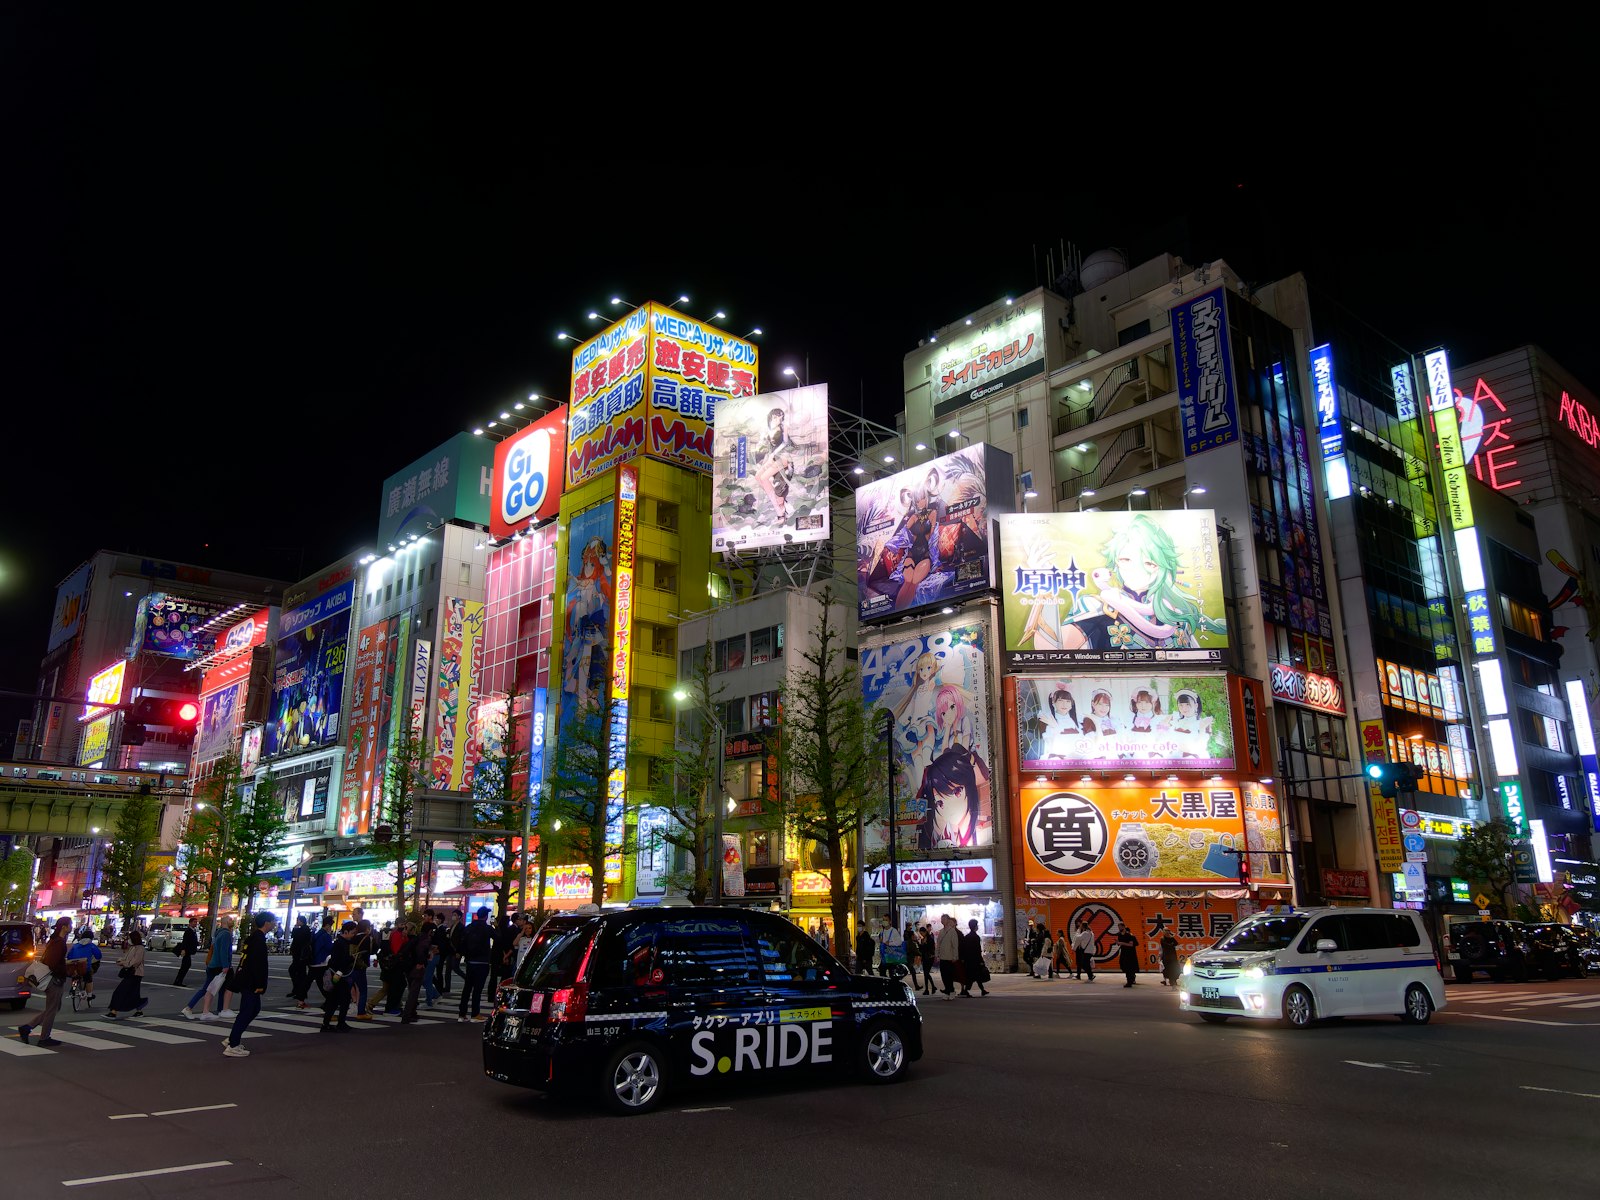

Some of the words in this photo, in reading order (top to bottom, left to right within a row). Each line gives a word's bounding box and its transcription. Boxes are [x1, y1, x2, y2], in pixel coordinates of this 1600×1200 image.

[573, 335, 646, 405] 激安販売
[654, 339, 755, 397] 激安販売
[941, 333, 1034, 393] メイドカジノ
[570, 373, 644, 443] 高額買取
[1255, 454, 1267, 471] 7F
[1441, 435, 1453, 466] Yellow
[1448, 473, 1464, 524] Submarine
[1014, 555, 1086, 613] 原神
[293, 602, 322, 626] ソフマップ
[325, 591, 347, 611] AKIBA
[1273, 605, 1285, 621] 5F
[1468, 594, 1495, 654] 秋葉館
[360, 634, 370, 651] 4F
[325, 643, 346, 669] 7.26
[416, 643, 428, 681] AKKY
[1074, 652, 1100, 660] Windows
[354, 690, 363, 707] 3F
[1272, 668, 1341, 709] メイドカジノ
[533, 712, 545, 746] GiGO
[1115, 742, 1148, 751] home
[1152, 742, 1178, 751] cafe
[347, 750, 358, 771] 2F
[1112, 810, 1147, 819] チケット
[1151, 791, 1238, 819] 大黒屋
[1406, 814, 1416, 823] 40
[1408, 839, 1416, 850] P
[1165, 899, 1213, 910] チケット
[1146, 912, 1236, 938] 大黒屋
[692, 1010, 775, 1030] タクシーアプリ
[788, 1009, 823, 1019] エスライド
[603, 1027, 620, 1035] 207
